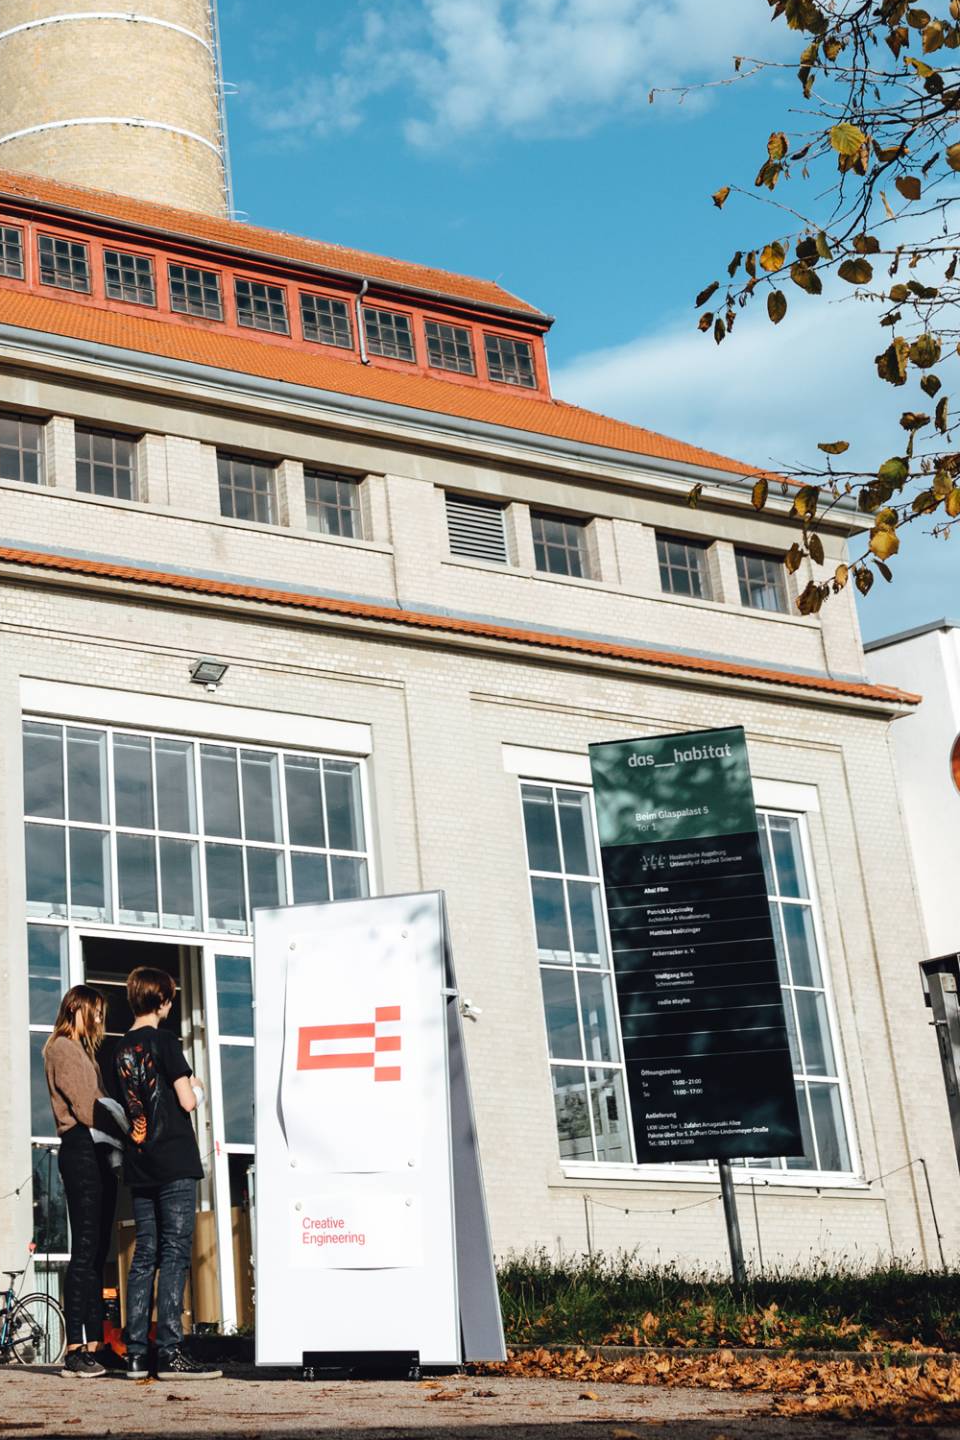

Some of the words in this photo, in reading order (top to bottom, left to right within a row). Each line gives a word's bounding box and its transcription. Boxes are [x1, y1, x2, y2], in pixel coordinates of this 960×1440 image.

[635, 812, 657, 822] Beim
[658, 808, 702, 820] Glaspalast
[302, 1216, 345, 1229] Creative
[302, 1231, 366, 1247] Engineering
